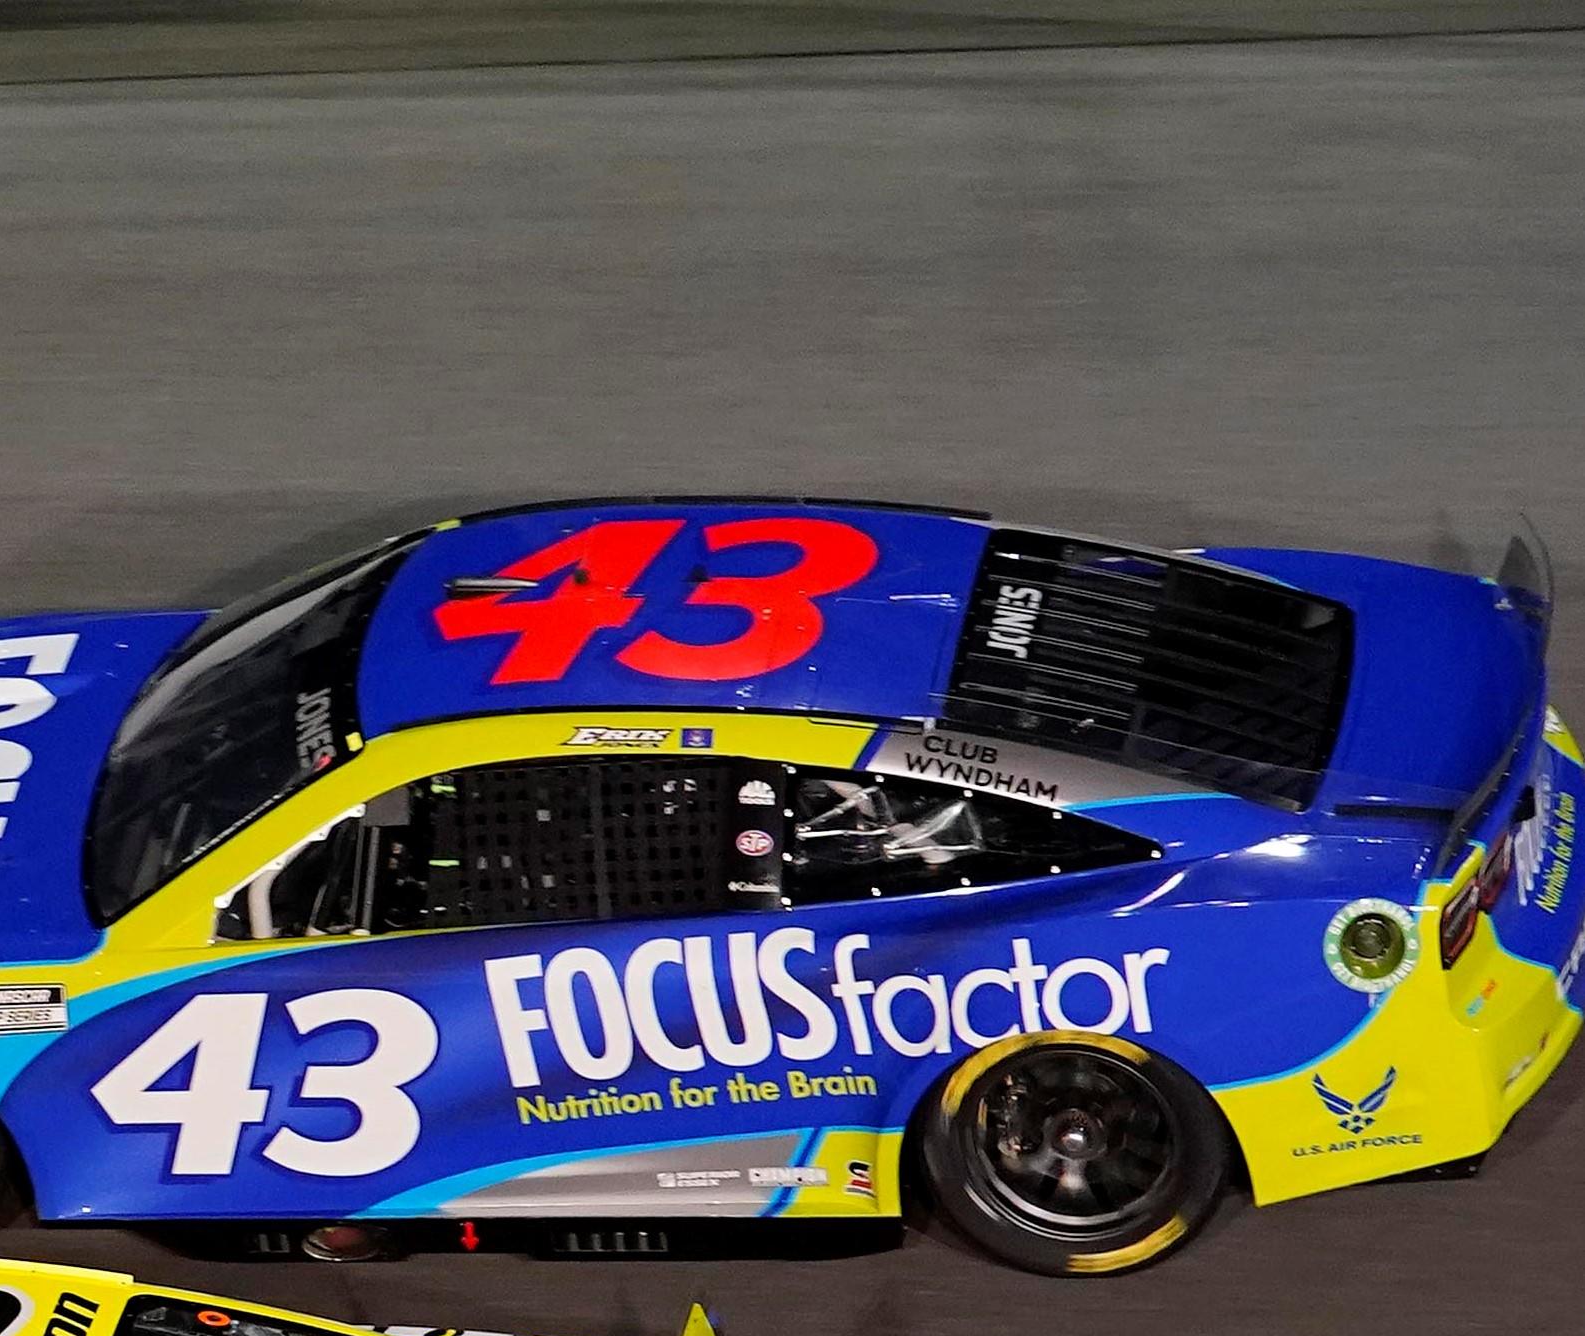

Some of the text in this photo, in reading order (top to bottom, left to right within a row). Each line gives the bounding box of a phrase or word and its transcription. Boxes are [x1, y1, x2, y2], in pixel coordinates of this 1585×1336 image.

[433, 517, 879, 685] 43
[923, 735, 998, 764] CLUB
[905, 752, 1058, 802] WYNDHAM
[90, 988, 439, 1178] 43
[516, 1066, 878, 1125] Nutrition for the Brain
[1328, 1140, 1357, 1152] AIR
[1361, 1133, 1423, 1148] FORCE
